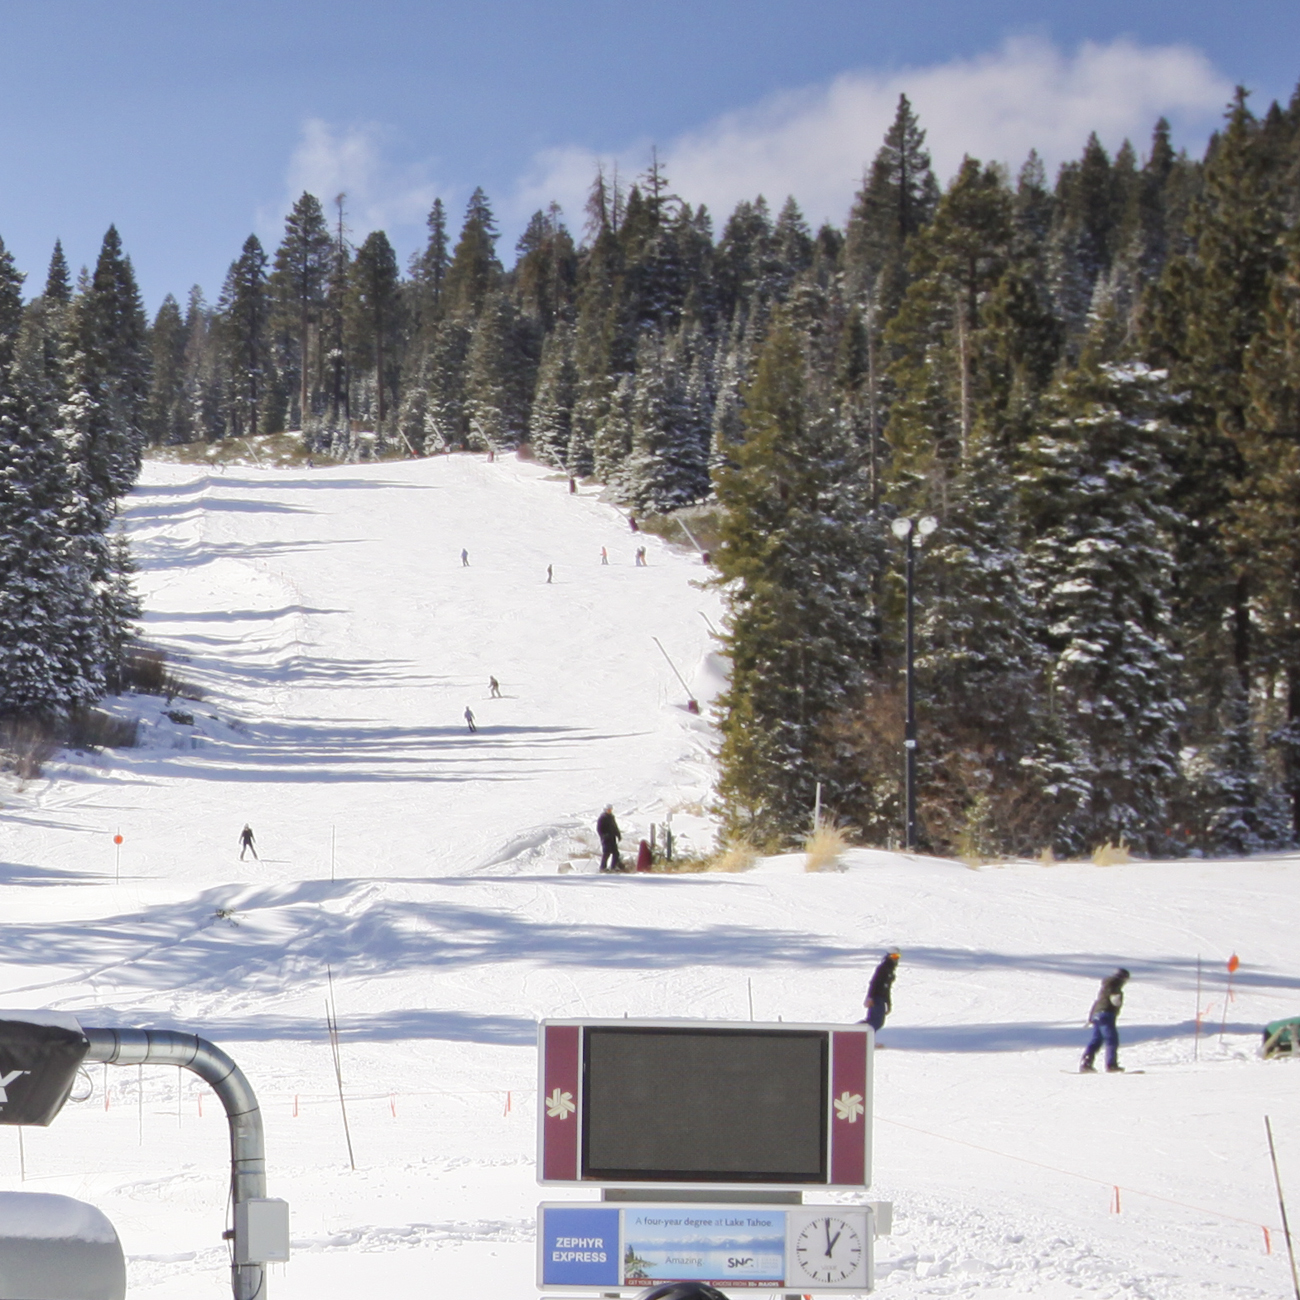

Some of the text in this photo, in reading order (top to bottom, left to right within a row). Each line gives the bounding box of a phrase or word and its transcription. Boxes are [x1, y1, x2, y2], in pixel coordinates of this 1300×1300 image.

[635, 1217, 643, 1226] A
[644, 1217, 682, 1228] four-year
[684, 1217, 713, 1228] degree
[725, 1218, 745, 1226] Lake
[555, 1238, 603, 1248] ZEPHYR
[552, 1252, 607, 1262] EXPRESS
